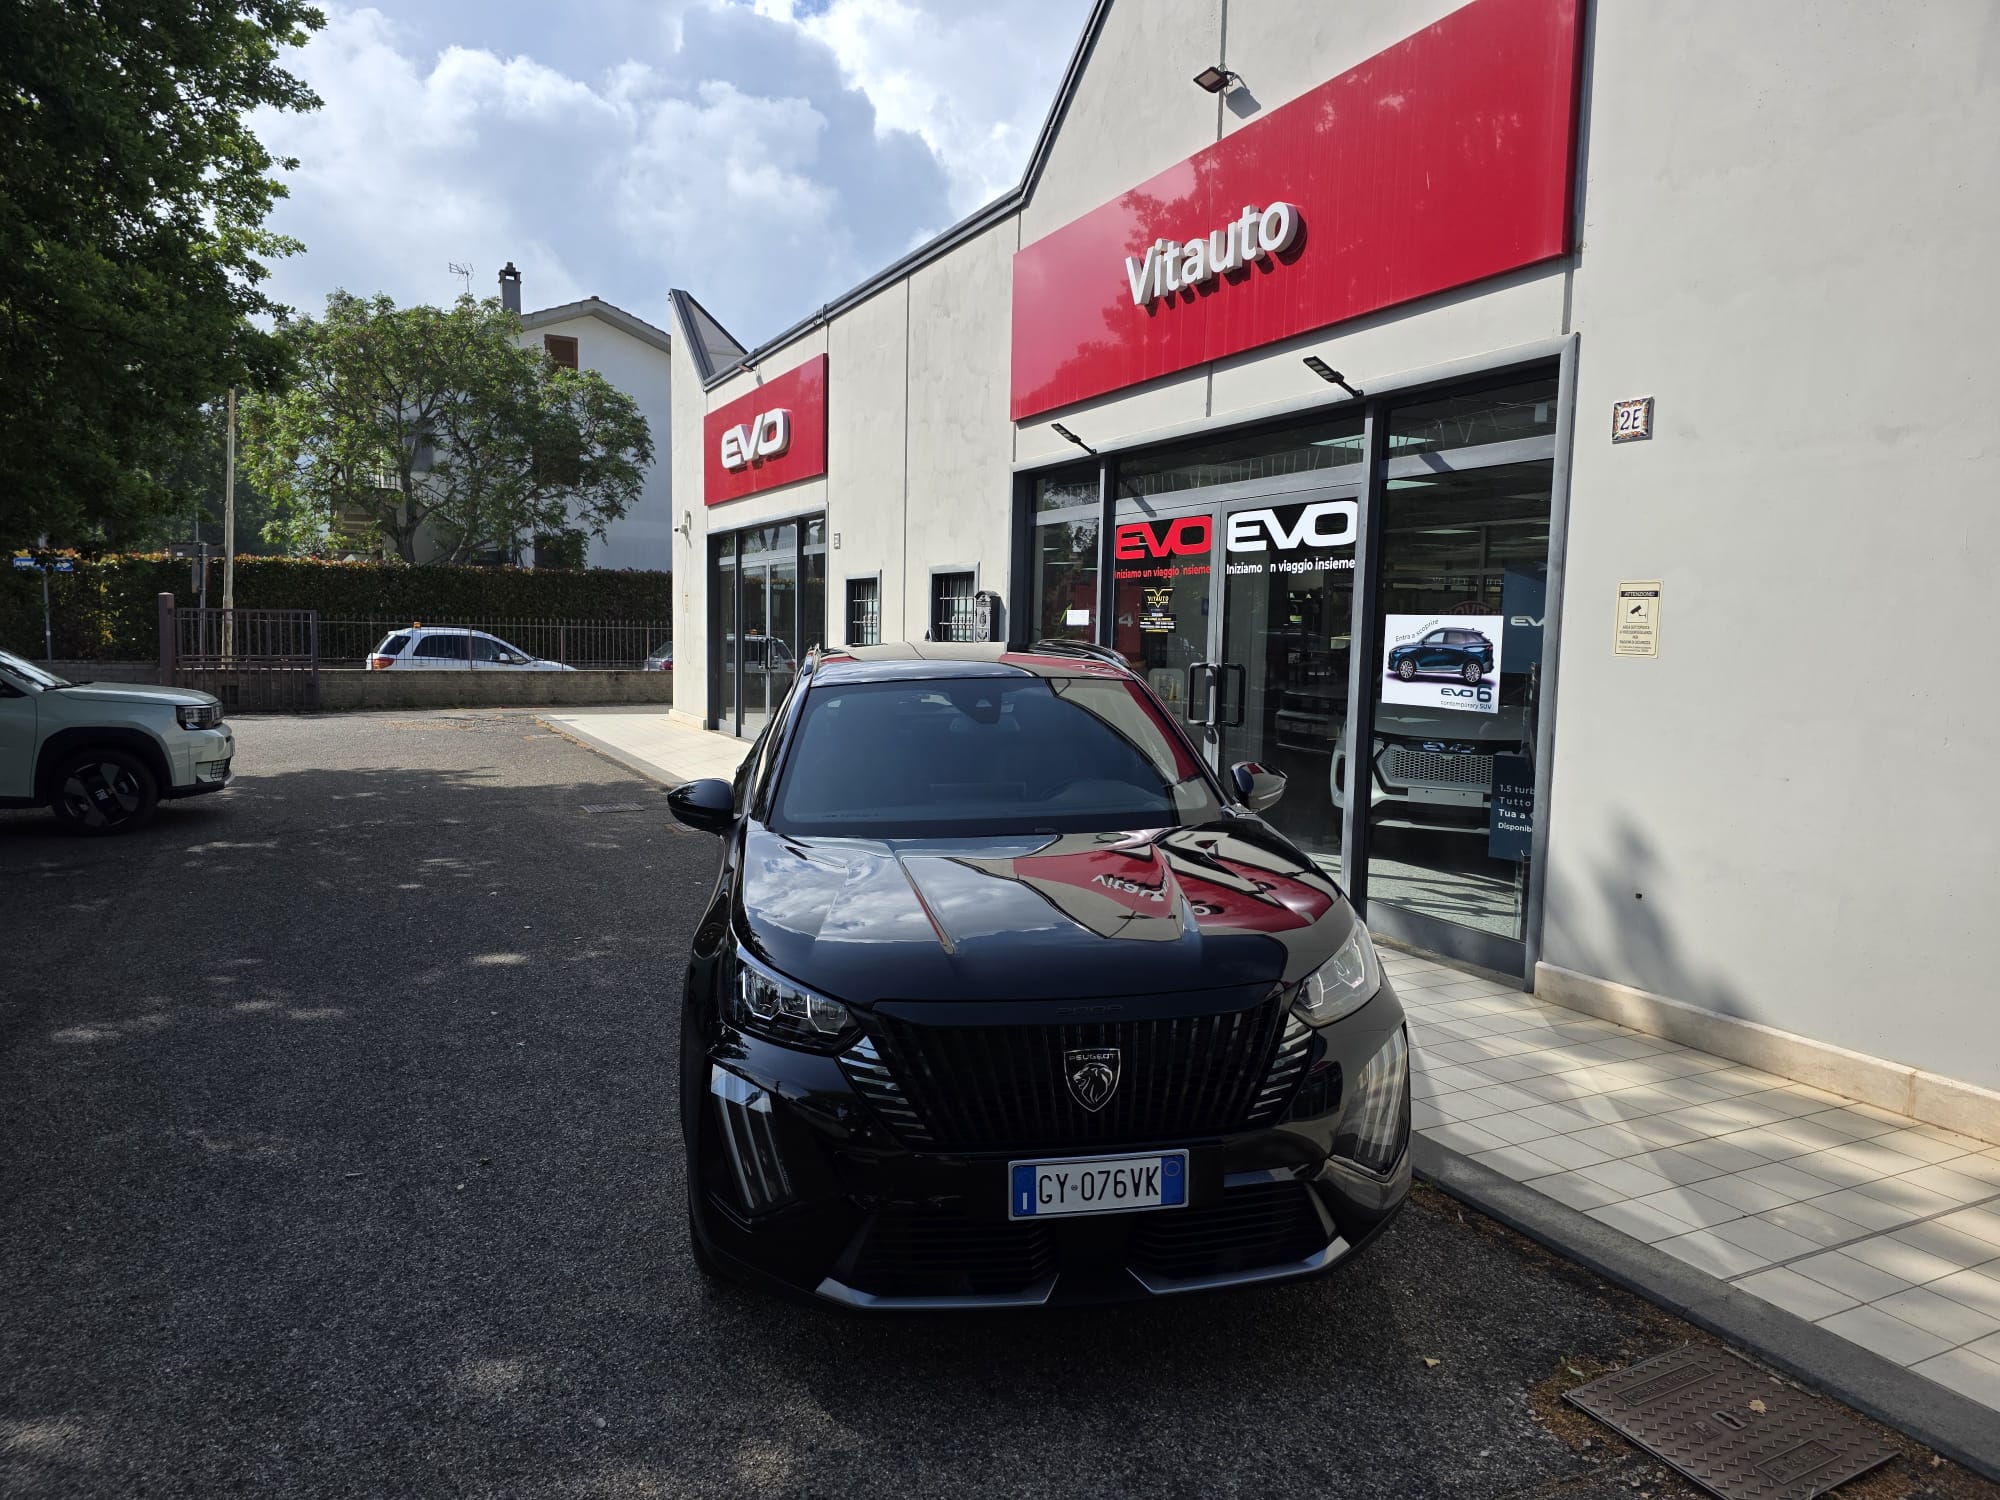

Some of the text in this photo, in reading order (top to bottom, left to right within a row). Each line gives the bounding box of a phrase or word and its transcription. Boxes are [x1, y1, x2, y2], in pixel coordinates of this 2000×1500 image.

[1125, 201, 1299, 305] Vitauto
[1620, 407, 1642, 431] 2E
[721, 408, 789, 469] EVO
[1227, 500, 1358, 552] EVO
[1116, 515, 1212, 560] EVO
[1153, 565, 1179, 578] viaggio
[1226, 562, 1263, 575] Iniziamo
[1278, 558, 1313, 574] viaggio
[1315, 556, 1356, 571] insieme
[1511, 615, 1545, 626] EV
[1395, 633, 1411, 642] Entra
[1416, 619, 1439, 635] scoprire
[1441, 684, 1492, 703] EVO 6
[1500, 784, 1512, 793] 1.5
[1499, 796, 1531, 807] Tutto
[1498, 808, 1517, 818] Tua
[1069, 1053, 1116, 1061] PEUGEOT
